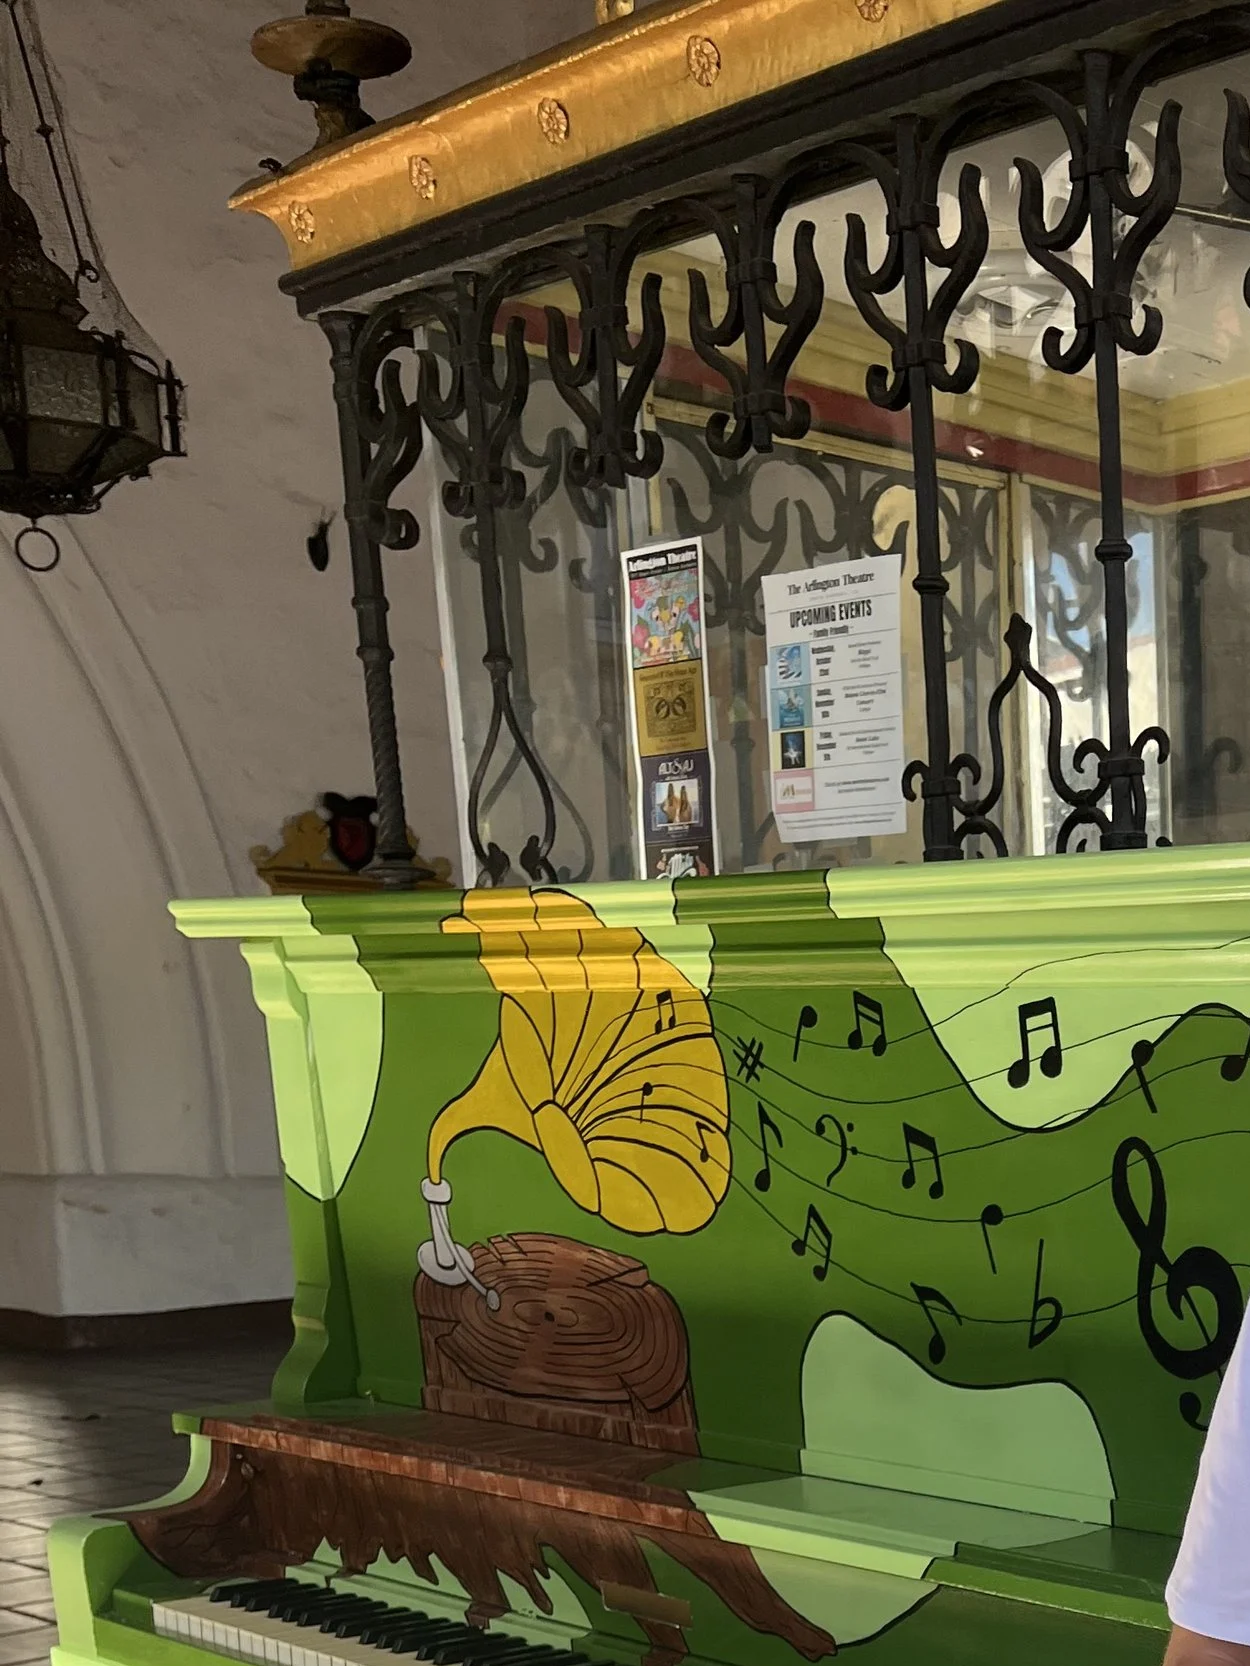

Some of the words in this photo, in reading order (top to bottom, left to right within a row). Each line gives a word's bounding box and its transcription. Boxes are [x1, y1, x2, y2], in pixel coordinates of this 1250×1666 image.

[787, 584, 801, 596] The
[804, 578, 840, 593] Arlington
[843, 572, 875, 586] Theatre
[790, 605, 836, 629] UPCOMING
[838, 599, 872, 621] EVENTS
